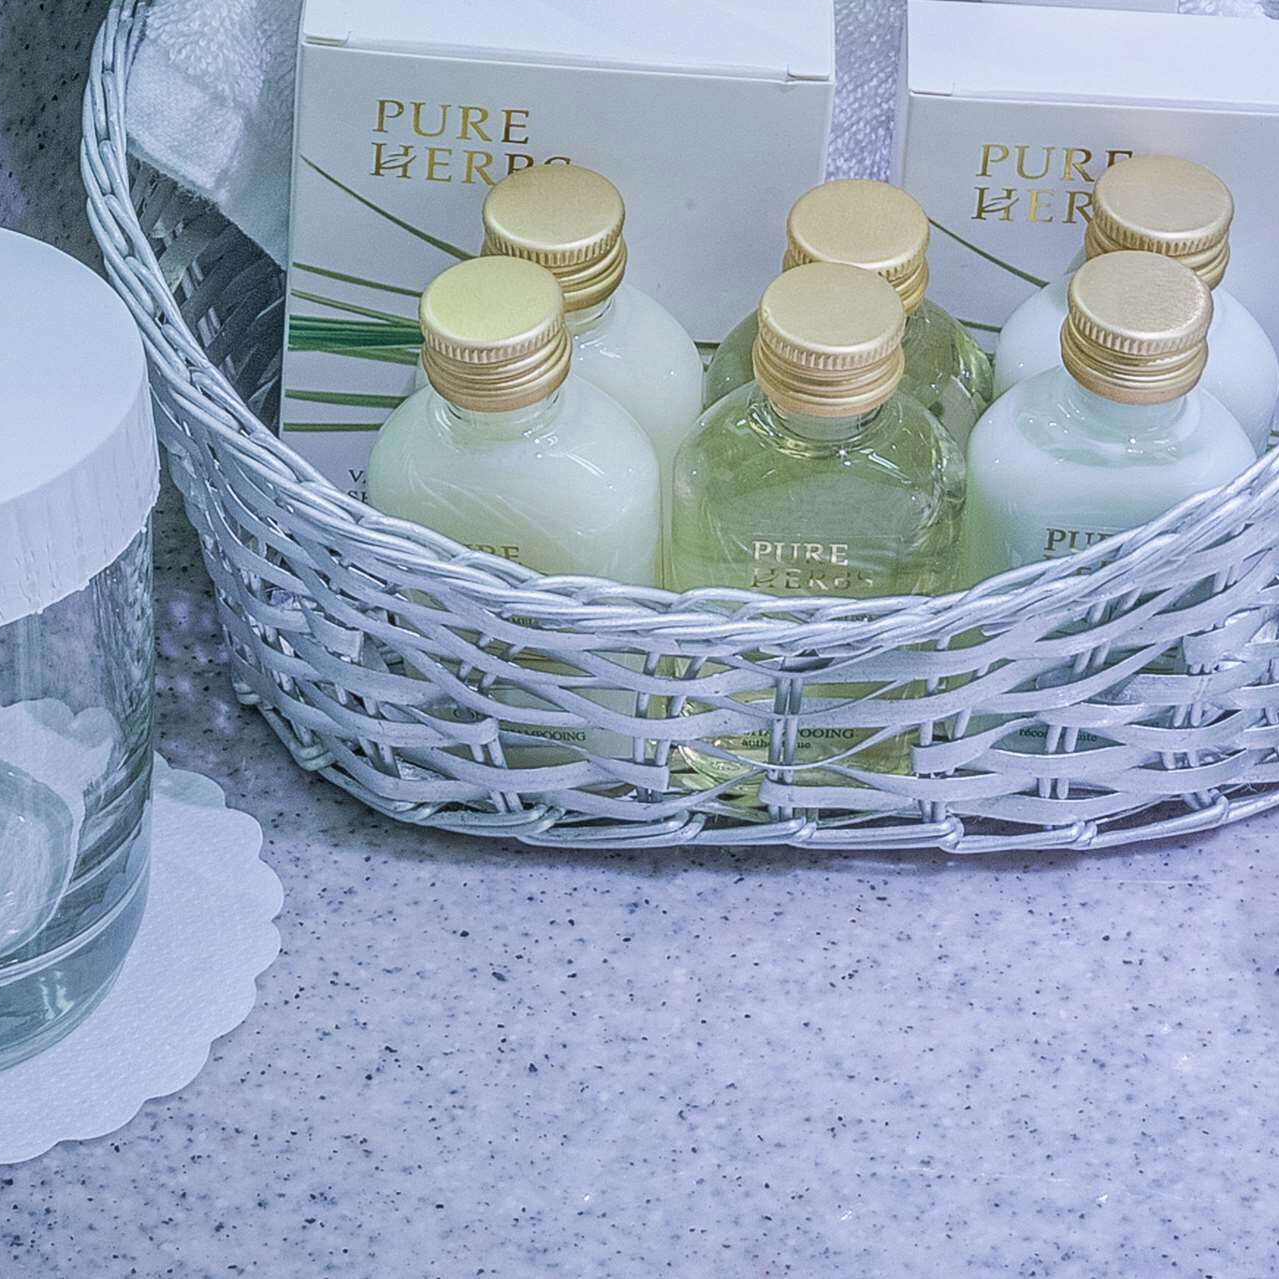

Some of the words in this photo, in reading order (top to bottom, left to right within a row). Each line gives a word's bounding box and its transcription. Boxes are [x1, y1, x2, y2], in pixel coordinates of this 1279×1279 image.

[372, 99, 529, 144] PURE
[369, 142, 572, 186] HER
[971, 186, 1093, 224] HER
[752, 540, 848, 566] PURE
